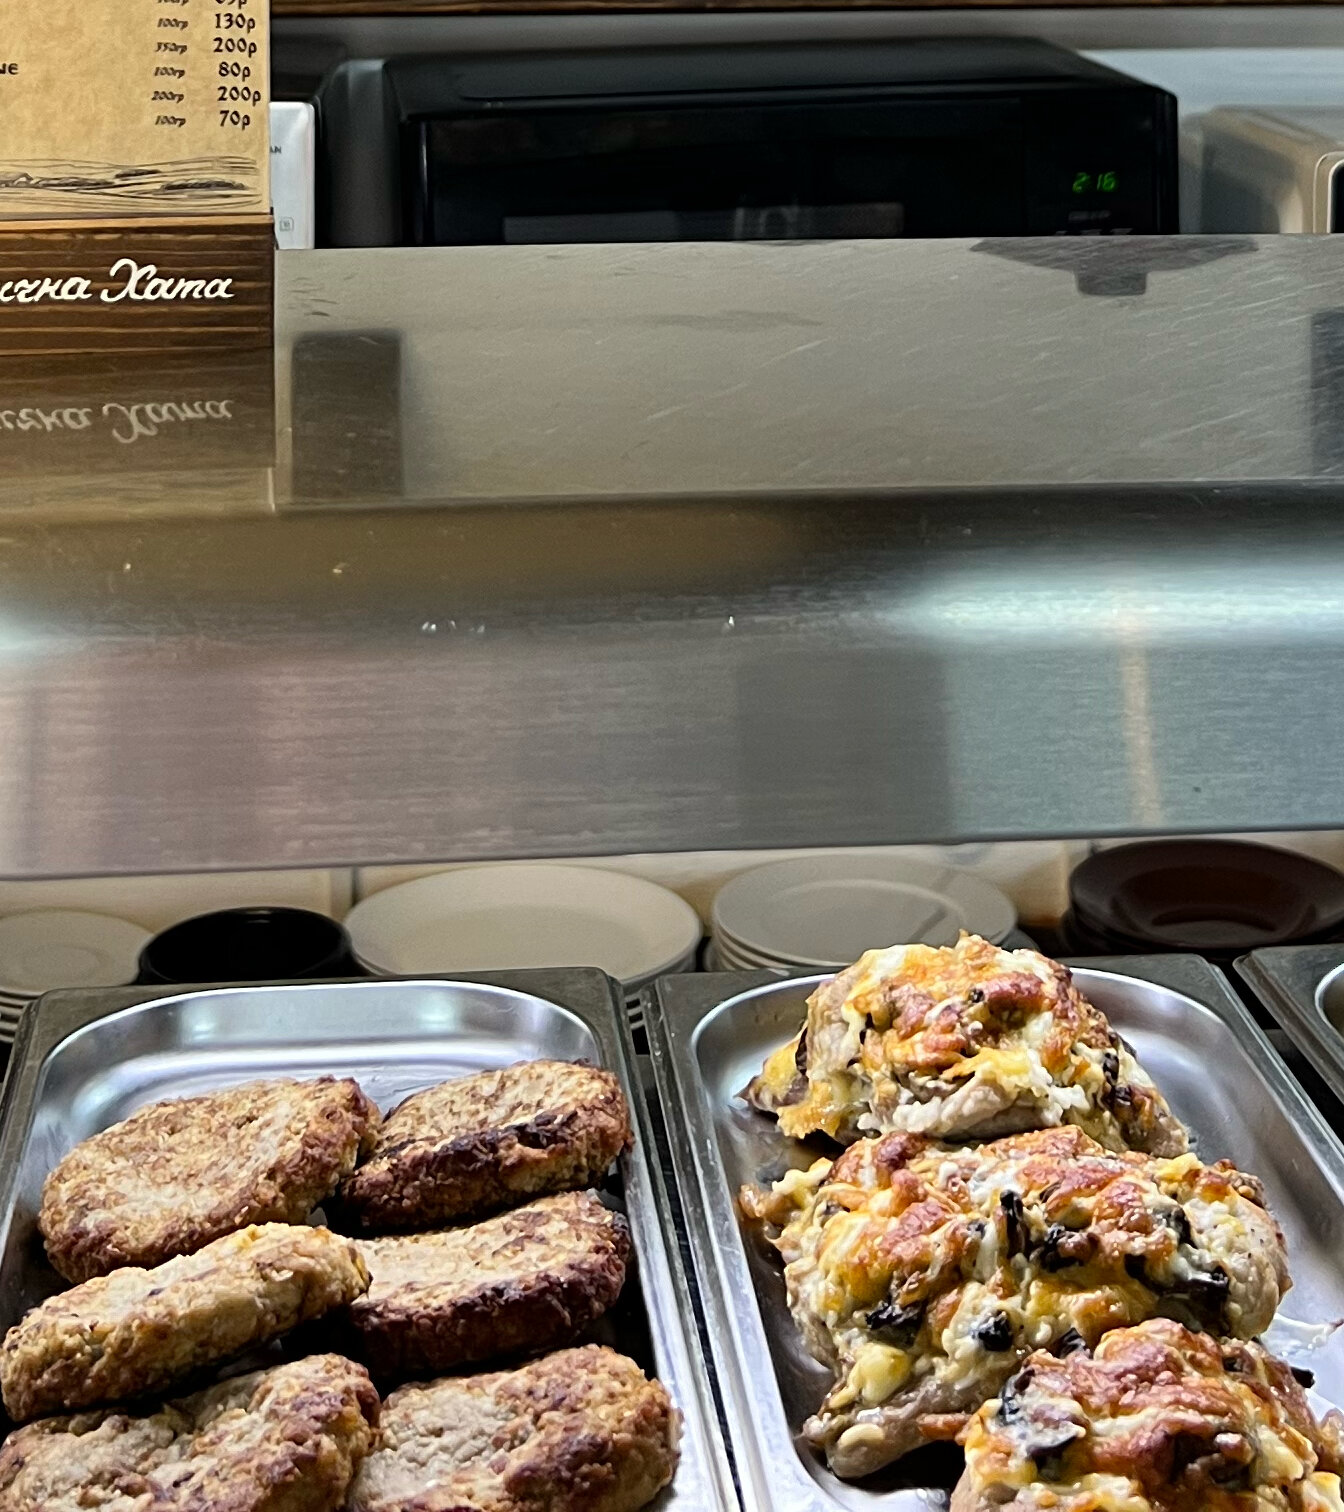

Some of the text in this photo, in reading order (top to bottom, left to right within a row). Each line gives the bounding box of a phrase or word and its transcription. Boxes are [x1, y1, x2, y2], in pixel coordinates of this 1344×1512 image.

[214, 12, 256, 34] 130р
[213, 36, 258, 59] 200р
[218, 61, 251, 83] 80р
[216, 85, 262, 107] 200р
[219, 109, 251, 131] 70р
